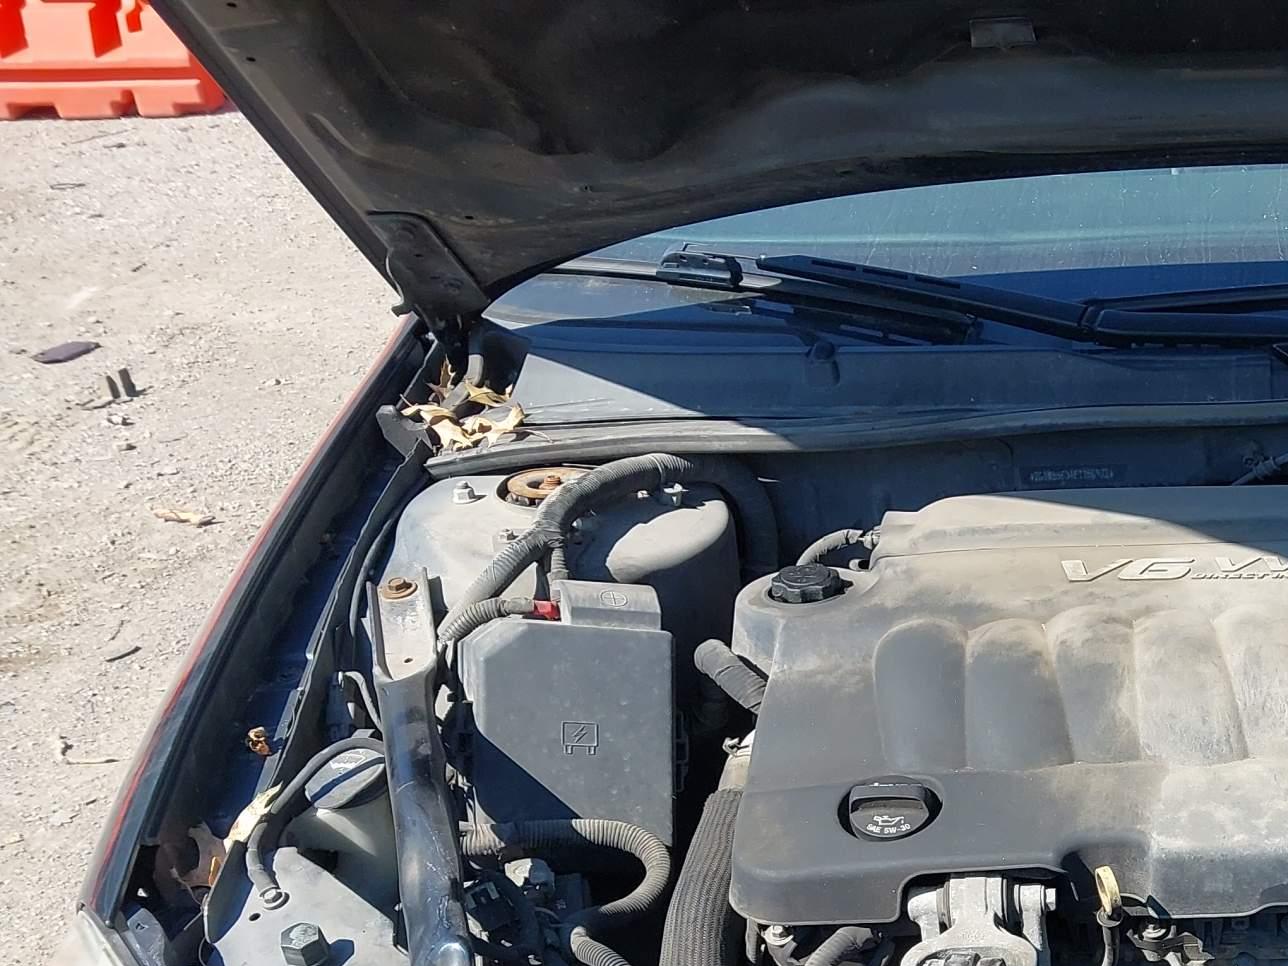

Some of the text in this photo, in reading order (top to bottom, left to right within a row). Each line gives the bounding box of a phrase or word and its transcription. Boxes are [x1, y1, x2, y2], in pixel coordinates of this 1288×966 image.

[1060, 558, 1196, 582] V6
[1191, 572, 1271, 580] DIRECT
[866, 823, 911, 834] SAE 5W-30
